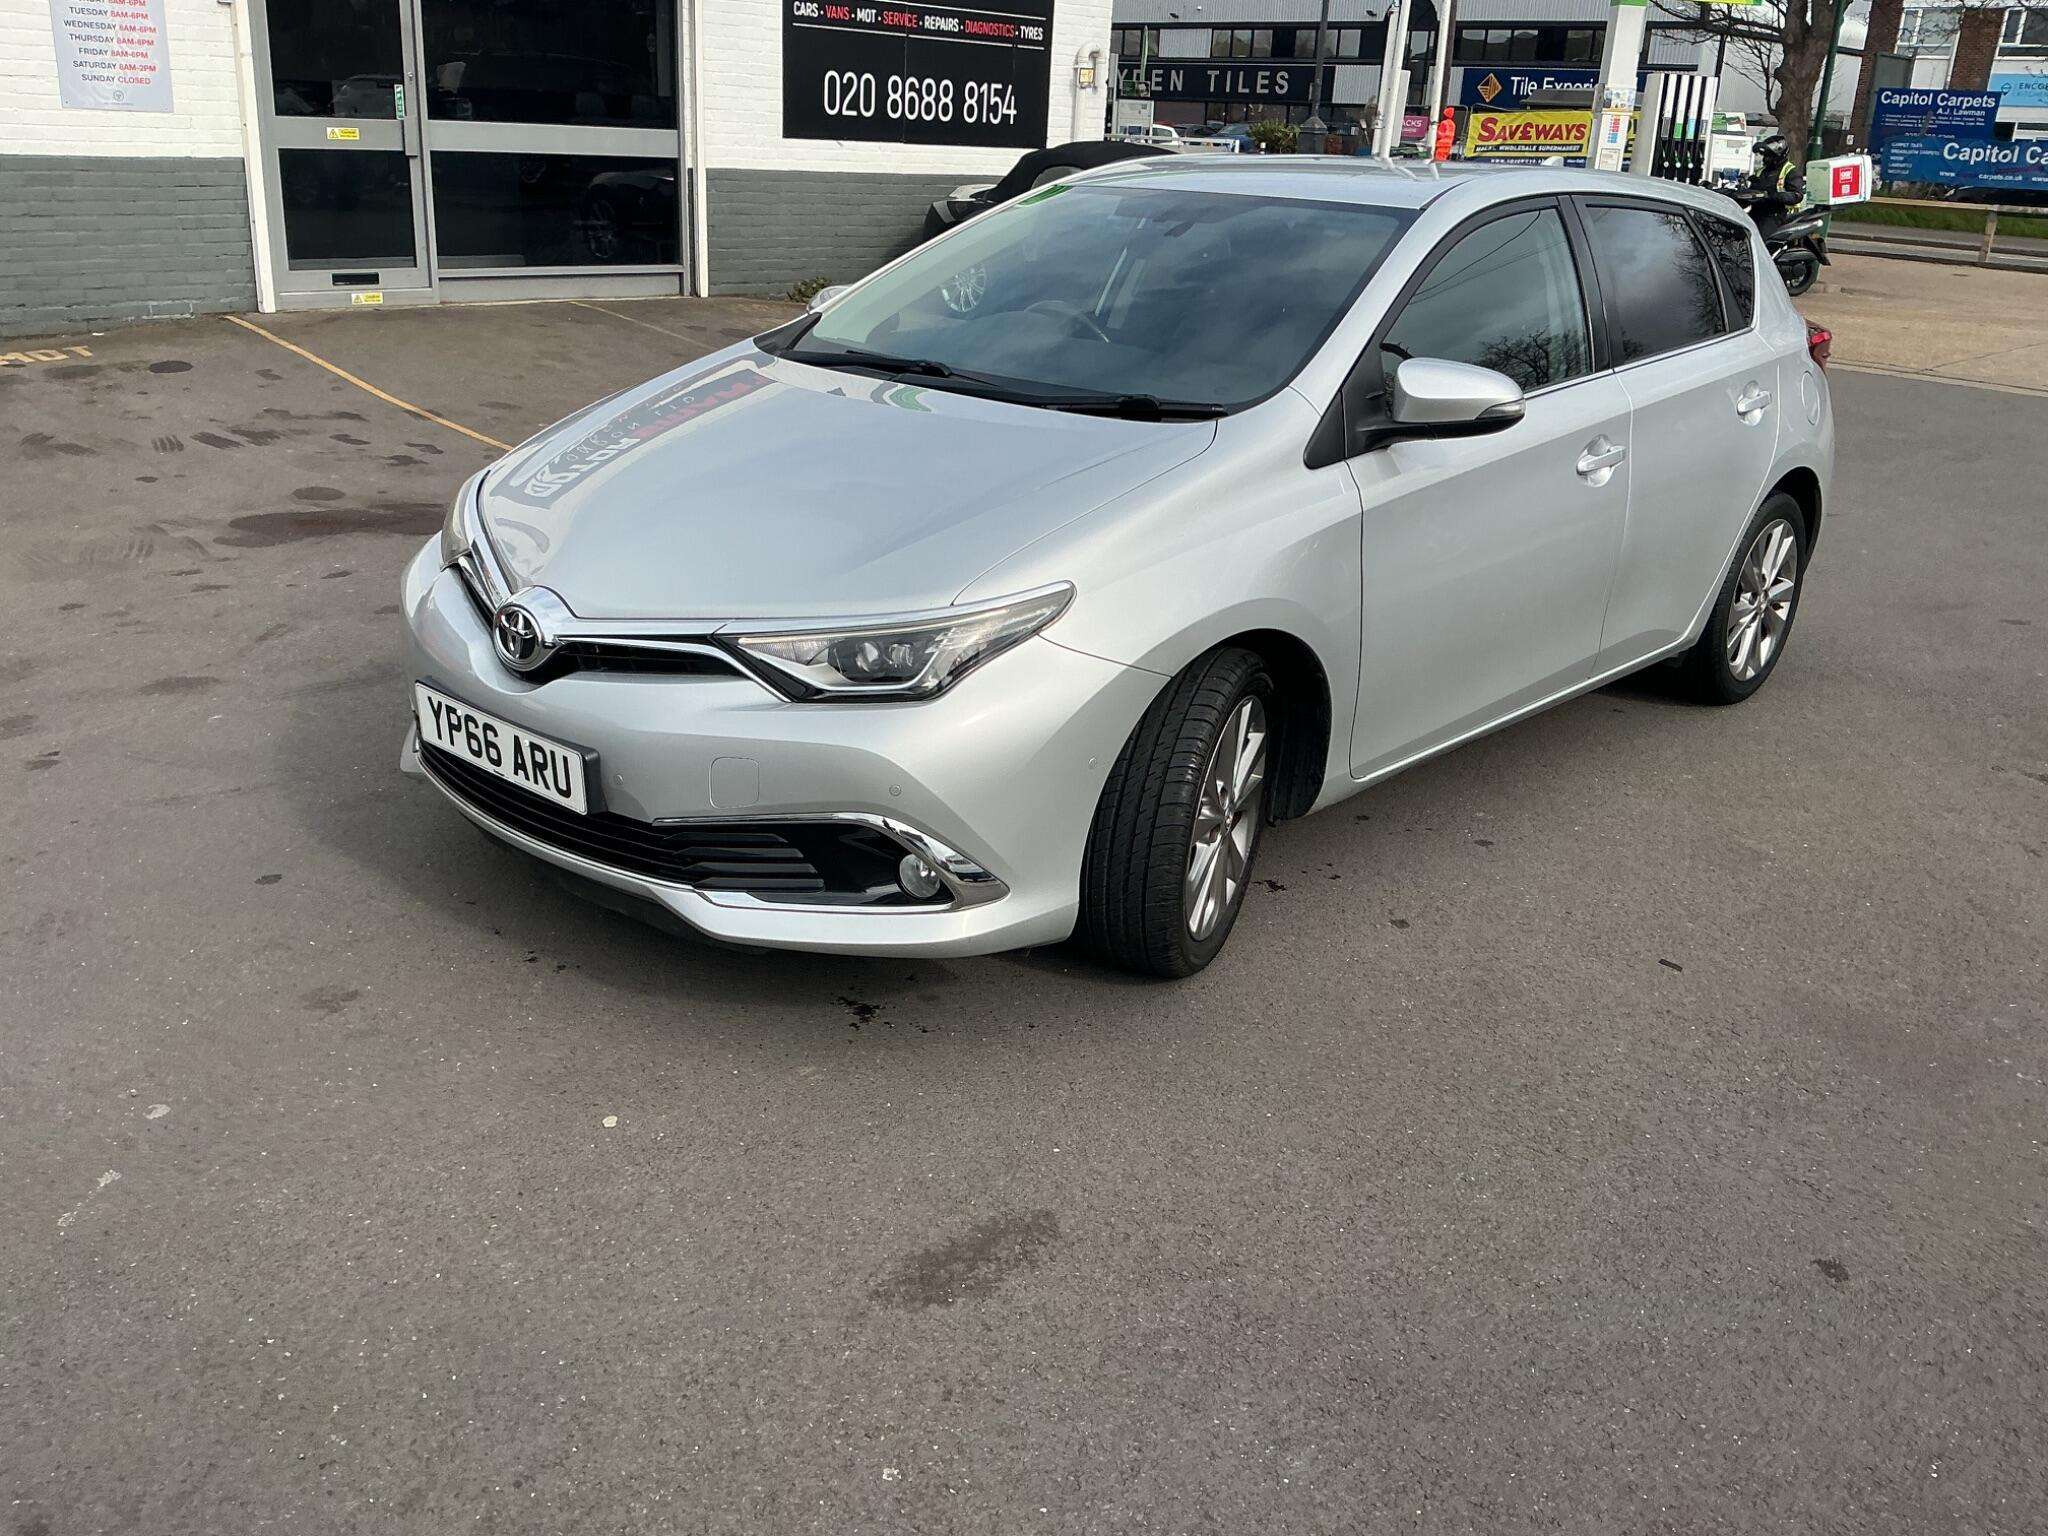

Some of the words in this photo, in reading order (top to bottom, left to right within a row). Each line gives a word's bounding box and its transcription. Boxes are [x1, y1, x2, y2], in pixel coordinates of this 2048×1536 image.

[69, 6, 108, 16] TUESDAY
[63, 20, 117, 30] WEDNESDAY
[793, 1, 819, 18] CARS
[825, 5, 850, 20] VANS
[857, 8, 877, 23] MOT
[882, 11, 918, 28] SERVICE
[924, 16, 960, 32] REPAIRS
[965, 20, 1016, 37] DIAGNOSTICS
[1020, 25, 1044, 41] TYRES
[68, 33, 115, 43] THURSDAY
[78, 47, 109, 56] FRIDAY
[72, 60, 117, 70] SATURDAY
[81, 74, 116, 83] SUNDAY
[117, 76, 152, 85] CLOSED
[1206, 69, 1290, 95] TILES
[1510, 76, 1538, 96] Tile
[823, 69, 876, 118] 020
[886, 74, 954, 123] 8688
[962, 80, 1018, 126] 8154
[1881, 90, 1934, 107] Capitol
[1937, 92, 1996, 110] Carpets
[1953, 109, 1986, 117] Lawman
[1498, 143, 1538, 153] WHOLESALE
[1537, 143, 1582, 153] SUPERMARKET
[1943, 142, 2020, 165] Capitol
[427, 695, 503, 768] YP66
[513, 734, 572, 799] ARU
